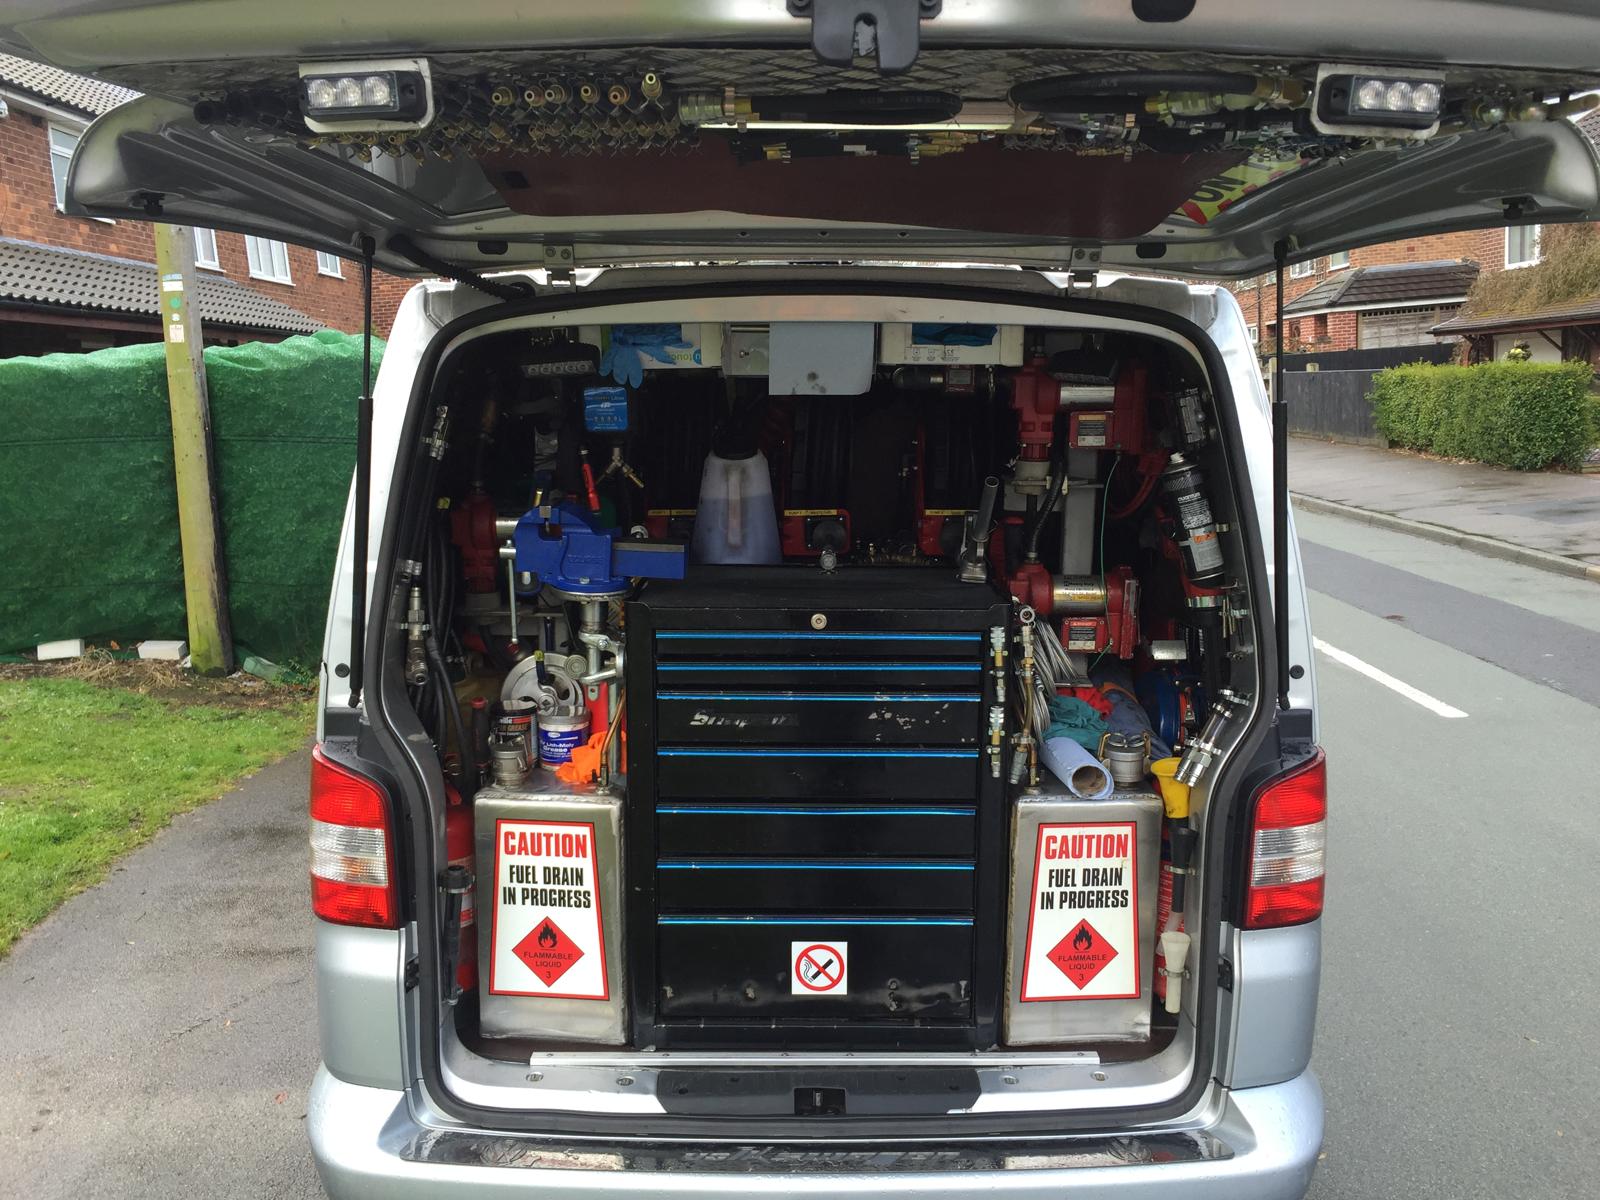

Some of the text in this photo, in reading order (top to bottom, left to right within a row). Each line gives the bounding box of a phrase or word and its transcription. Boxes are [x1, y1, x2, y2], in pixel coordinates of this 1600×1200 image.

[504, 831, 587, 858] CAUTION
[1044, 834, 1128, 859] CAUTION
[509, 865, 584, 886] FUEL DRAIN
[1048, 868, 1123, 887] FUEL DRAIN
[503, 887, 591, 908] IN PROGRESS
[1040, 890, 1128, 909] IN PROGRESS
[524, 951, 573, 960] FLAMMABLE
[1058, 954, 1107, 962] FLAMMABLE
[546, 971, 552, 979] 3
[1069, 962, 1096, 970] LIQUID
[1079, 973, 1085, 981] 3
